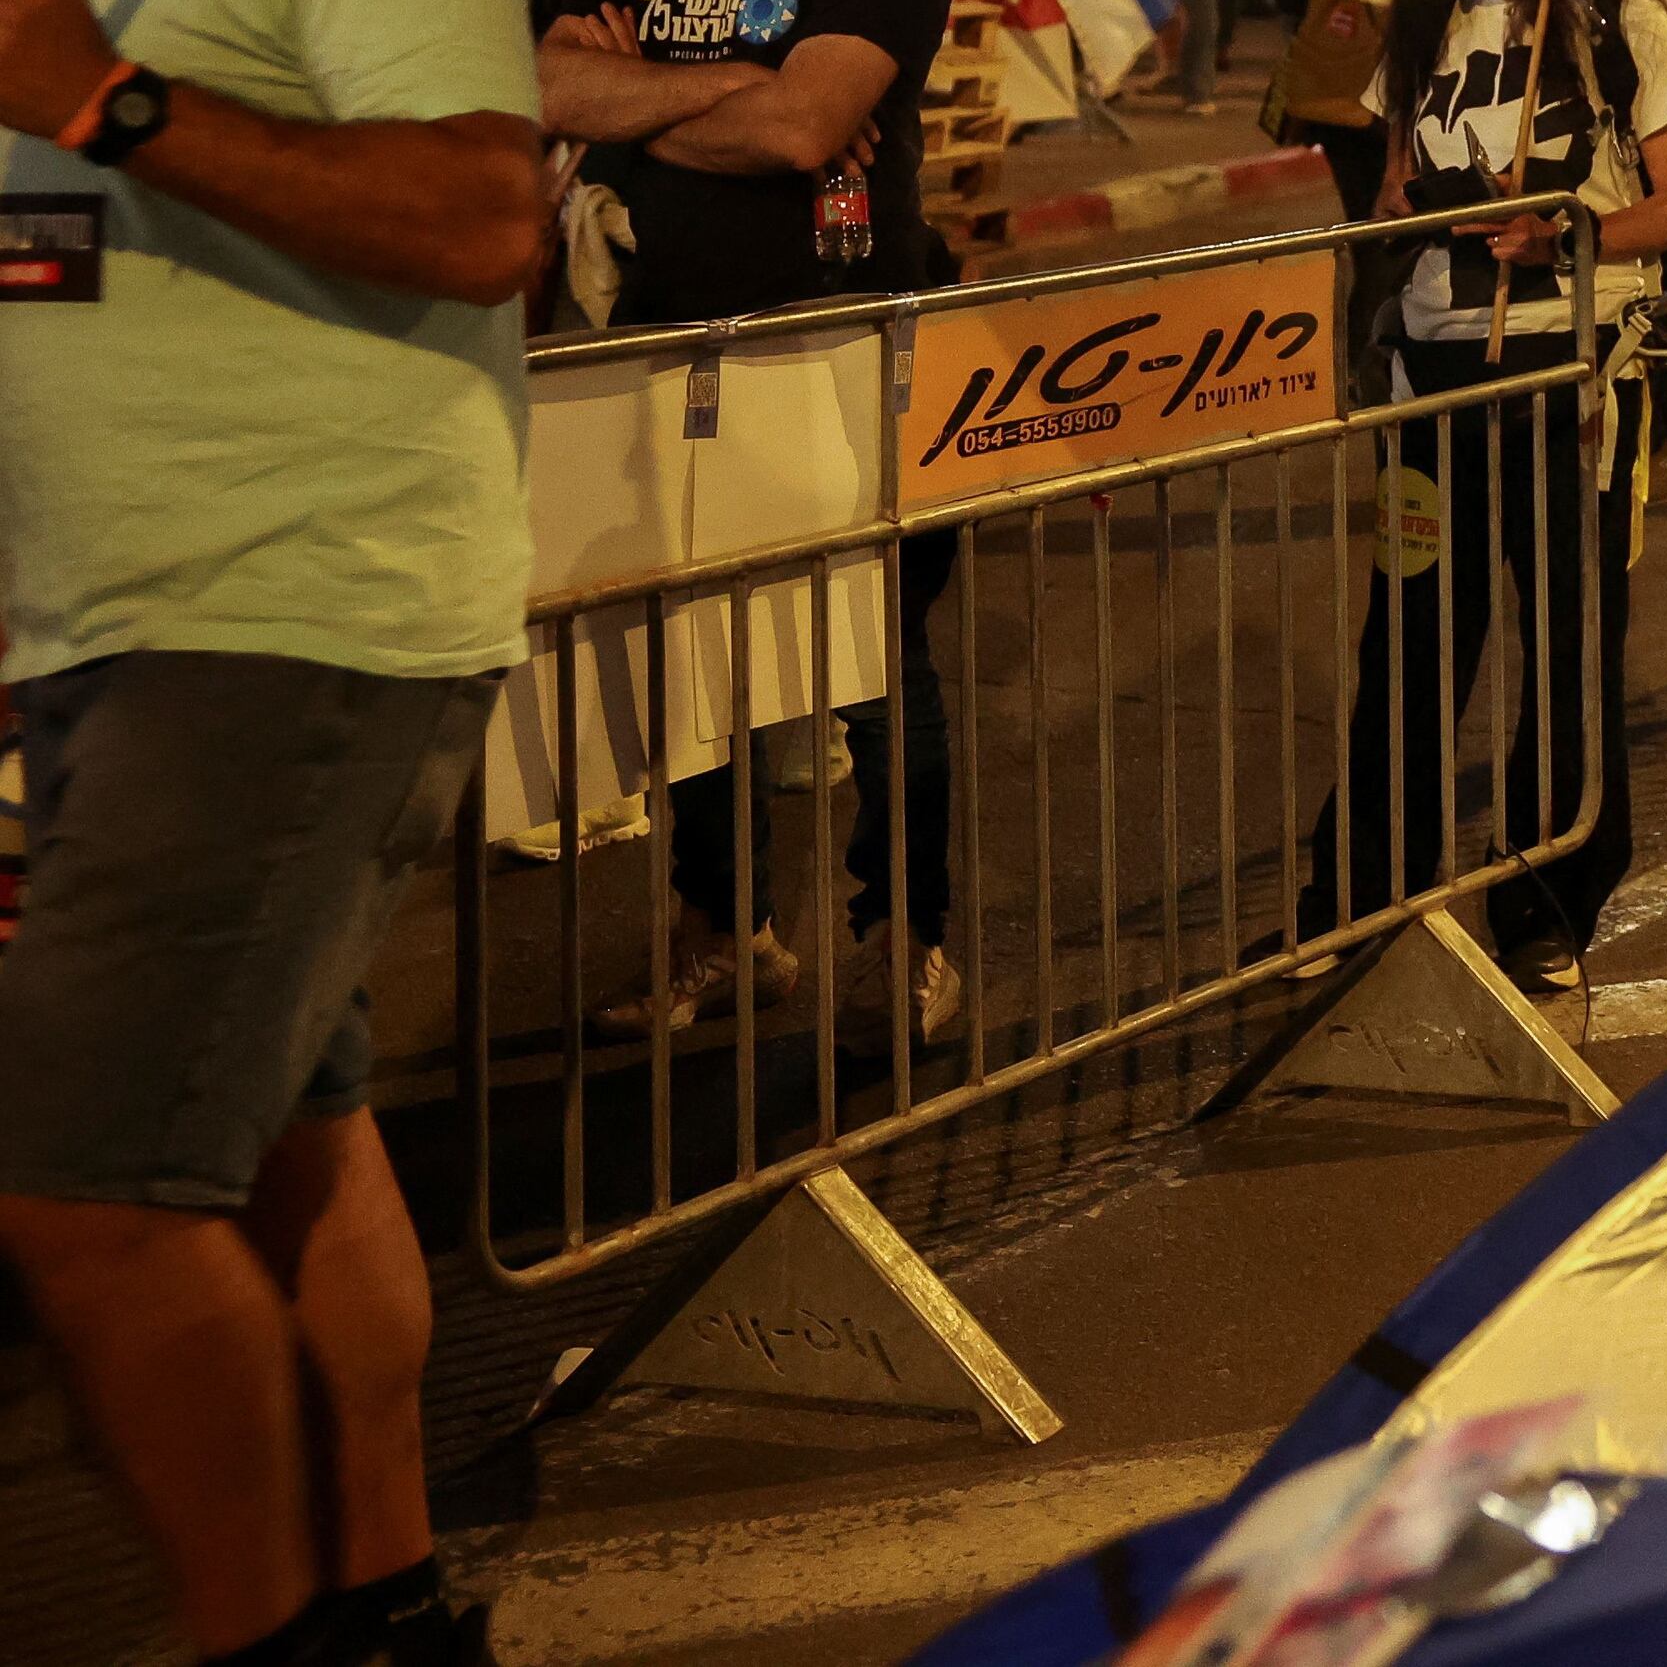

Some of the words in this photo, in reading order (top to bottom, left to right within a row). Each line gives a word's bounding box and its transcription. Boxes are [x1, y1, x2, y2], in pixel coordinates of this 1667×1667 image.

[919, 310, 1319, 467] רון-טון
[1195, 376, 1272, 412] לארועים
[1279, 371, 1317, 396] ציוד
[963, 406, 1115, 454] 054-5559900
